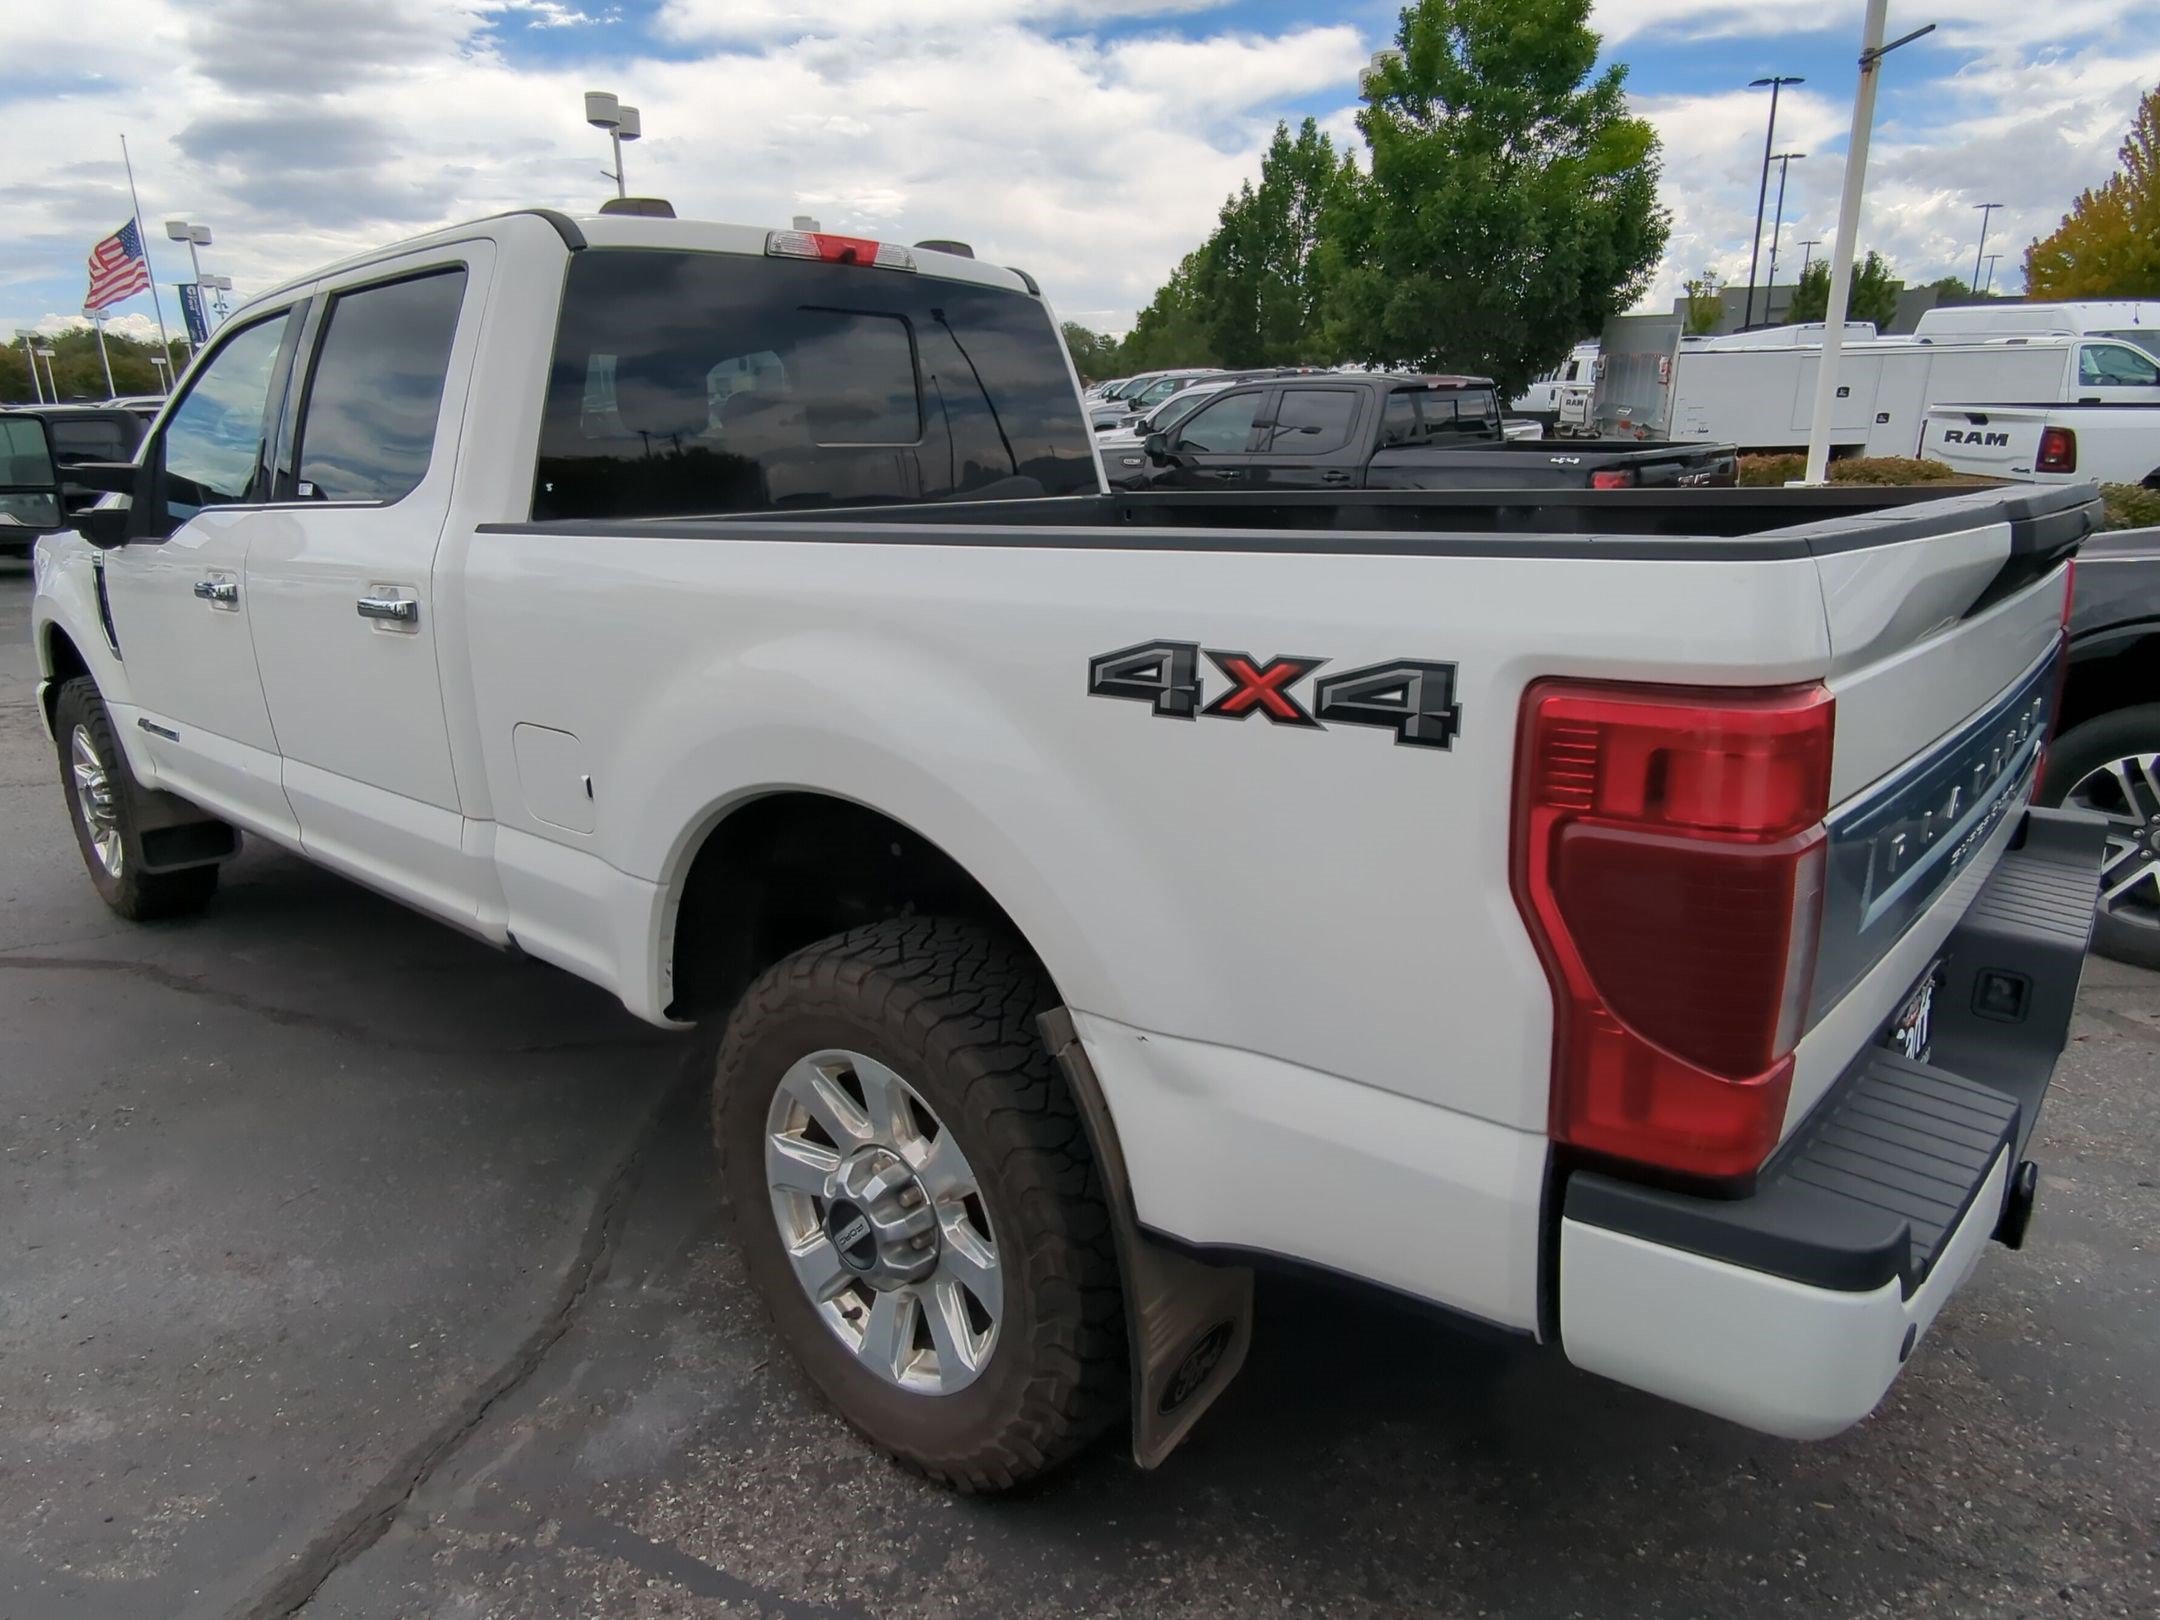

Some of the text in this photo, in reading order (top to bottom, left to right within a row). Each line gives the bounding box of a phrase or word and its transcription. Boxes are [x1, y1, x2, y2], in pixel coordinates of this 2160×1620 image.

[1566, 399, 1584, 407] RAM
[1944, 430, 2009, 447] RAM
[1087, 639, 1462, 752] 4X4
